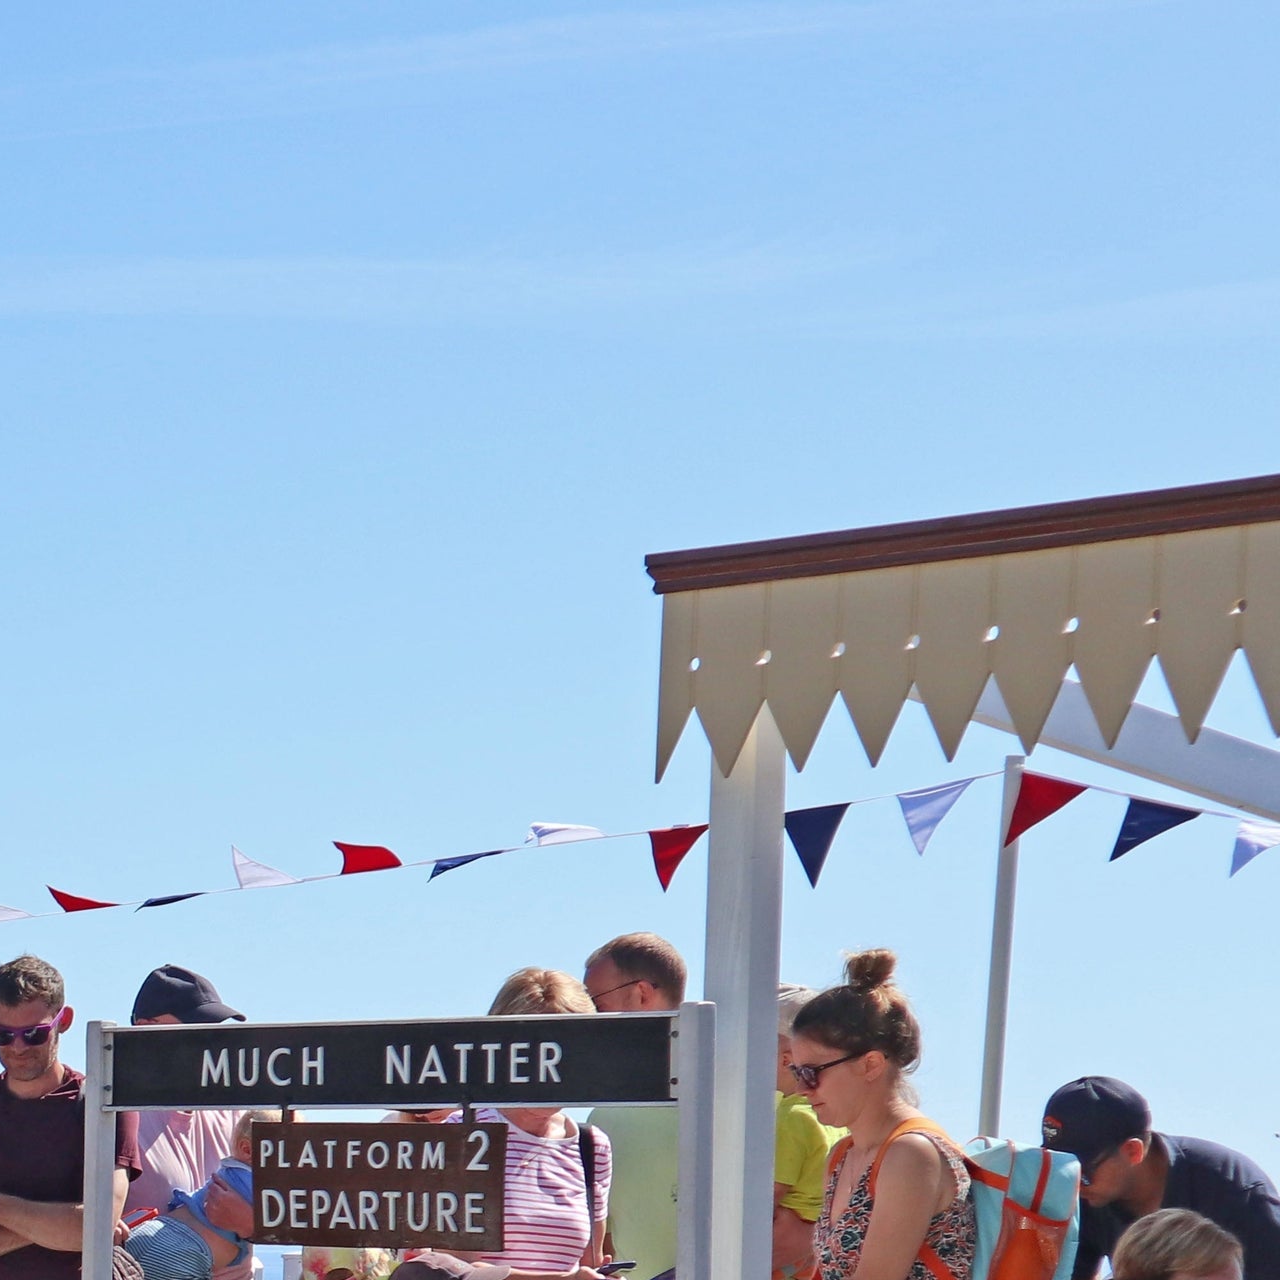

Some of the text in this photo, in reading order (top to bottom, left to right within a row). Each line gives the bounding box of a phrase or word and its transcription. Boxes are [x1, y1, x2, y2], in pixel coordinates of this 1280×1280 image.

[200, 1041, 563, 1088] MUCH NATTER
[259, 1130, 490, 1171] PLATFORM 2
[260, 1188, 486, 1234] DEPARTURE
